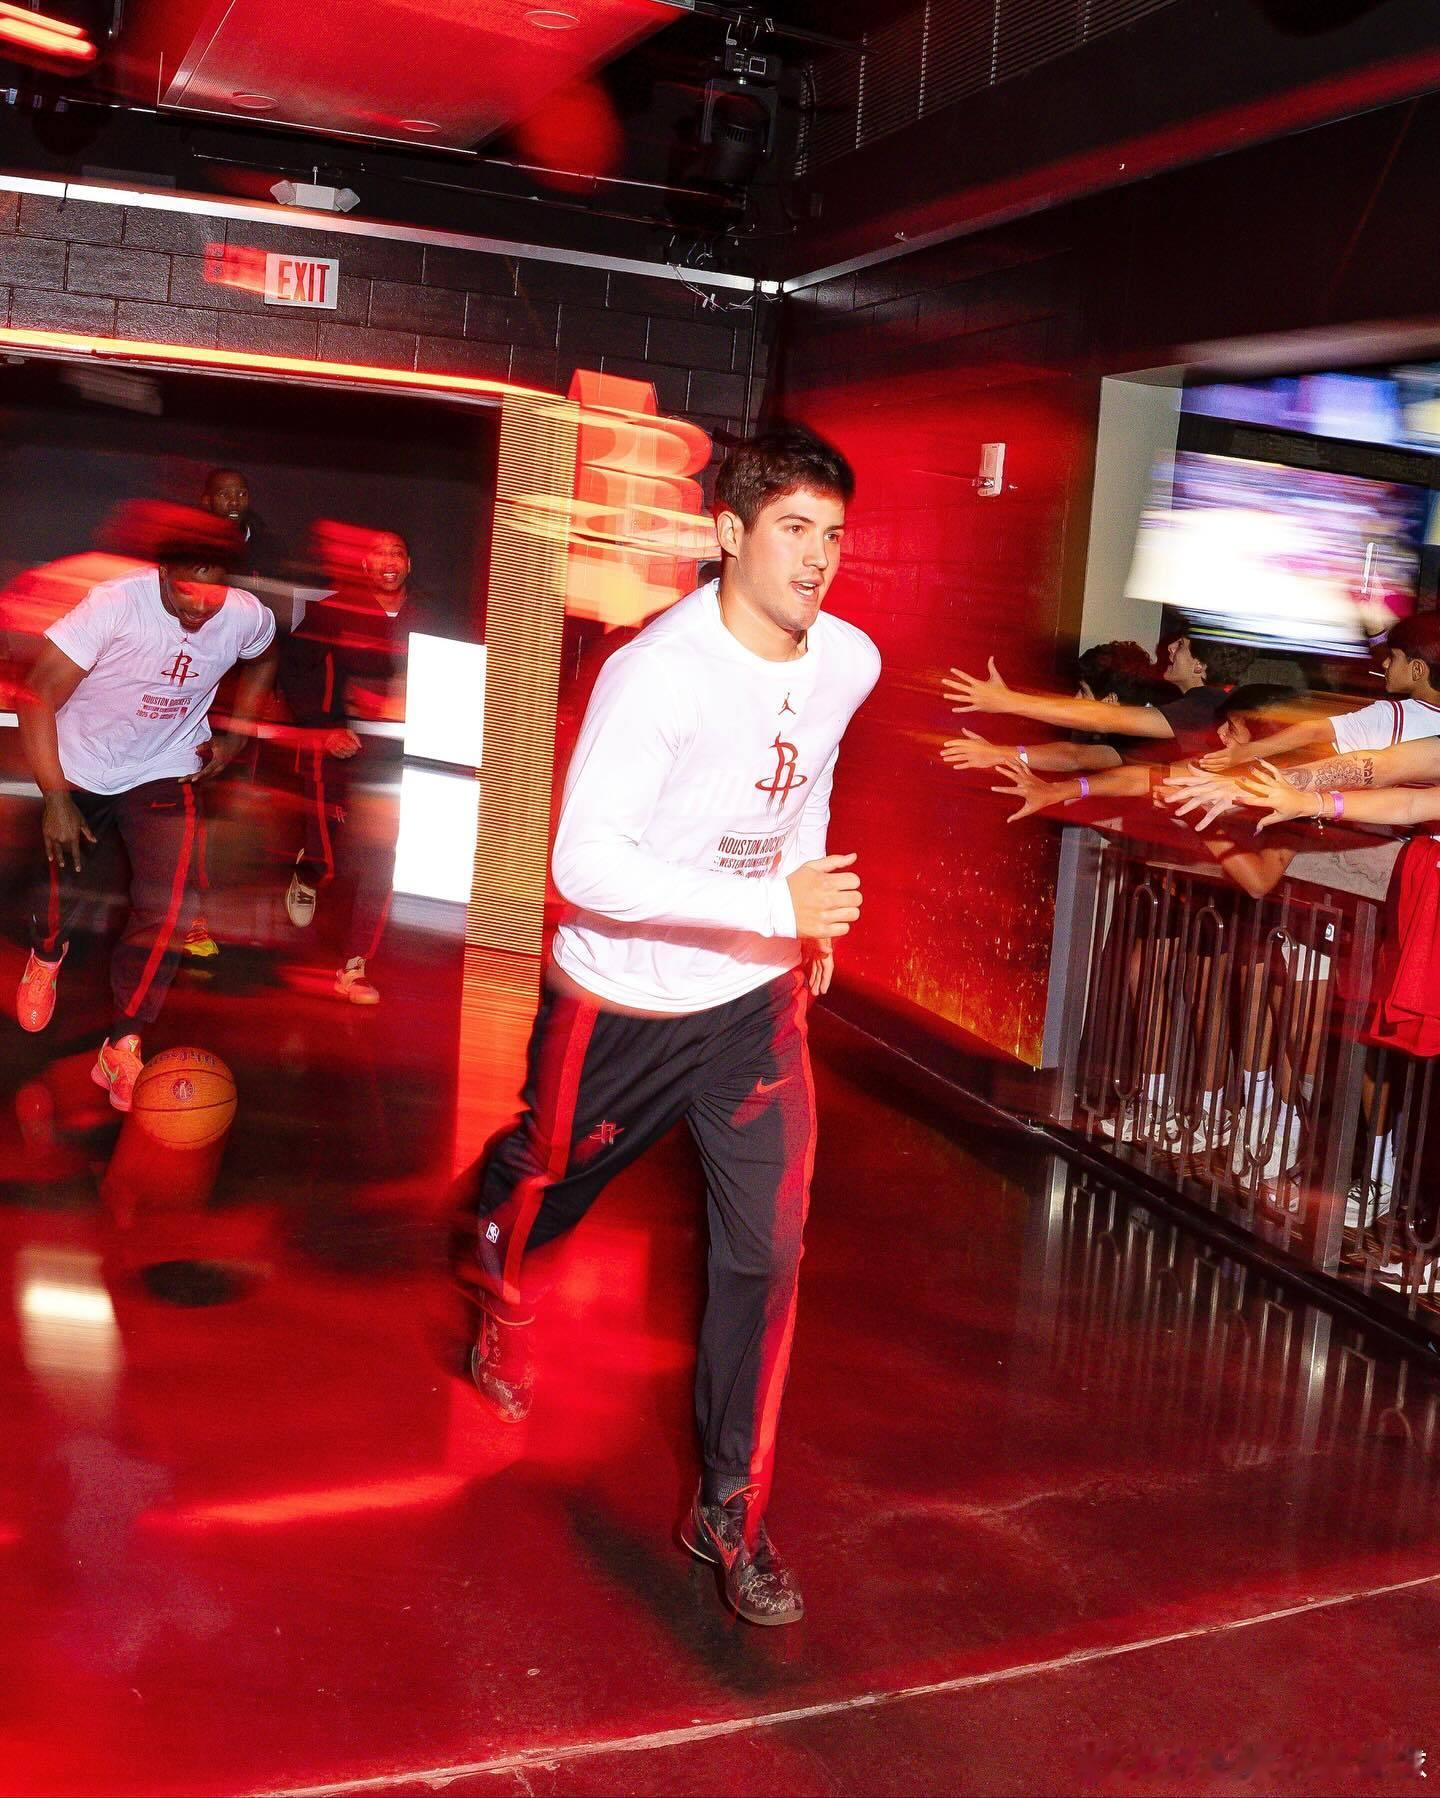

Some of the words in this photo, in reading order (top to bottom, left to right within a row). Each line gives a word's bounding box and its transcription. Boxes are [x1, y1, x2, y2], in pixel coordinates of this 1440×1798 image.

[278, 260, 330, 302] EXIT
[142, 694, 169, 706] HOUSTON
[718, 836, 763, 856] HOUSTON
